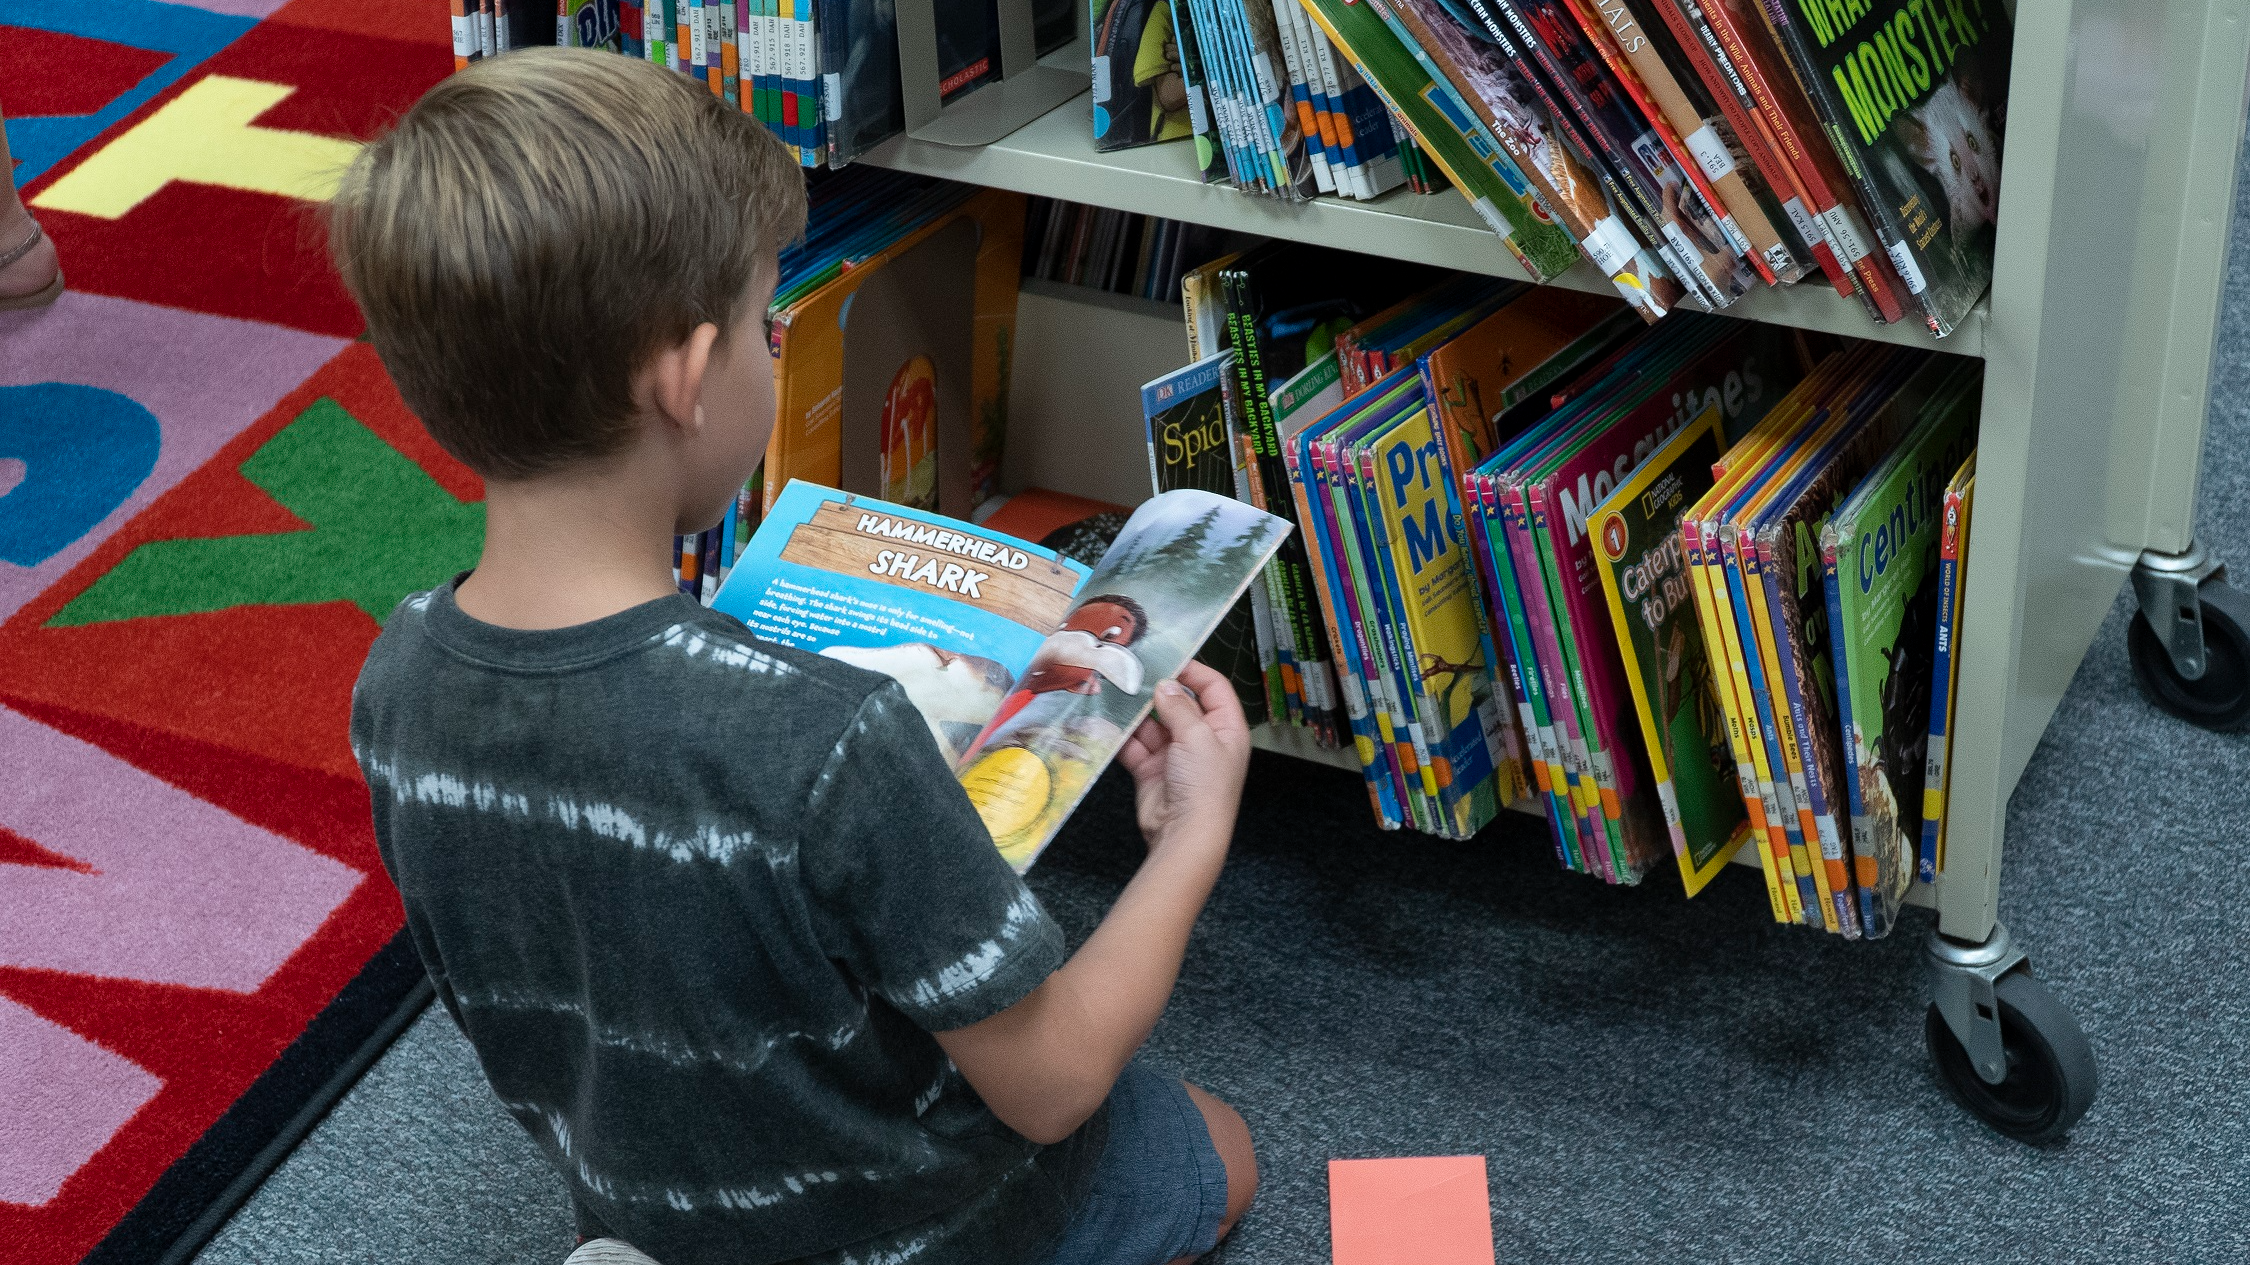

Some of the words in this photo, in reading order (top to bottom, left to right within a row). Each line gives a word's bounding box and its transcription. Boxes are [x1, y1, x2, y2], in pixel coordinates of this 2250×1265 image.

[1468, 0, 1488, 19] CEAN
[1483, 17, 1517, 57] MONSTERS
[1503, 8, 1538, 48] MONSTERS
[1798, 0, 1871, 48] WHA
[1282, 36, 1291, 50] KLI
[1317, 47, 1327, 61] KLI
[1582, 24, 1601, 48] Animal
[1597, 47, 1616, 71] Clowns
[1699, 24, 1719, 48] DEADLY
[1712, 46, 1749, 96] PREDATORS
[1698, 58, 1712, 75] HOW
[1708, 73, 1721, 90] AND
[1727, 103, 1737, 114] DO
[1714, 19, 1724, 29] in
[1719, 28, 1732, 43] the
[1727, 41, 1744, 63] Wild:
[1739, 62, 1763, 94] Animals
[1758, 93, 1773, 110] and
[1767, 108, 1785, 131] Their
[1779, 129, 1803, 160] Friends
[1353, 62, 1365, 74] my
[1362, 72, 1380, 90] little
[1376, 88, 1392, 105] book
[1389, 102, 1399, 113] of
[1395, 111, 1419, 137] animals
[1489, 119, 1509, 139] The
[1502, 135, 1523, 156] Zoo
[1699, 149, 1719, 173] 591.3
[1711, 152, 1726, 169] BEA
[1625, 174, 1636, 187] Free
[1633, 185, 1656, 214] Augmented
[1608, 181, 1619, 193] Free
[1616, 191, 1640, 220] Augmented
[1636, 217, 1651, 234] Reality
[1647, 233, 1658, 245] App
[1788, 207, 1805, 225] KAL
[1827, 209, 1842, 227] AMU
[1722, 218, 1738, 235] McG
[1799, 223, 1816, 242] 591.5
[1817, 219, 1830, 236] DEL
[1908, 222, 1918, 234] the
[1669, 235, 1685, 253] CAR
[1736, 235, 1750, 250] 591
[1828, 237, 1848, 266] 591.53
[1838, 227, 1861, 258] 591.56
[1597, 250, 1614, 265] HOE
[1665, 257, 1681, 275] CAR
[1681, 251, 1695, 265] 591
[1677, 273, 1689, 286] 591
[1862, 269, 1880, 293] Press
[1182, 295, 1194, 323] Looking
[1225, 311, 1245, 365] BEASTIES
[1240, 313, 1261, 366] BEASTIES
[1156, 384, 1174, 402] DK
[1177, 366, 1219, 394] READER
[1237, 366, 1248, 378] IN
[1251, 368, 1263, 380] IN
[1239, 379, 1252, 397] MY
[1254, 382, 1266, 399] MY
[1164, 402, 1226, 469] Spid
[1244, 398, 1264, 455] BACKYARD
[1257, 400, 1278, 457] BACKYARD
[1652, 472, 1674, 498] NATIONAL
[1653, 476, 1684, 510] GEOGRAPHIC
[1451, 512, 1462, 526] Do
[856, 514, 1029, 570] HAMMERHEAD
[1455, 527, 1467, 544] You
[1610, 529, 1621, 550] 1
[1458, 545, 1473, 570] Know
[869, 550, 989, 598] SHARK
[779, 579, 830, 598] hammerhead
[830, 592, 859, 605] shark's
[860, 601, 878, 610] nose
[879, 604, 886, 612] is
[888, 608, 905, 618] only
[905, 610, 919, 620] for
[1416, 582, 1432, 596] by
[1943, 587, 1949, 596] OF
[753, 610, 772, 619] near
[772, 615, 791, 624] each
[791, 620, 807, 628] eye.
[809, 623, 841, 636] Because
[765, 587, 806, 605] breathing.
[809, 599, 824, 608] The
[824, 603, 847, 614] shark
[848, 609, 876, 621] swings
[876, 615, 888, 624] its
[890, 618, 910, 630] head
[909, 626, 927, 636] side
[928, 630, 938, 639] to
[779, 604, 809, 618] forcing
[809, 611, 833, 622] water
[834, 617, 851, 627] into
[858, 623, 888, 636] nostril
[1642, 595, 1662, 631] to
[759, 625, 791, 636] nostrils
[791, 631, 806, 640] are
[1329, 625, 1342, 654] Crickets
[1351, 620, 1371, 660] Dragonflies
[1367, 619, 1387, 668] Grasshoppers
[1938, 625, 1948, 652] ANTS
[1382, 622, 1404, 670] Walkingsticks
[1397, 621, 1413, 650] Praying
[1405, 649, 1421, 681] Mantises
[1509, 663, 1522, 690] Beetles
[1526, 665, 1540, 696] Fireflies
[1573, 669, 1589, 709] Mosquitoes
[1558, 682, 1570, 699] Flies
[1792, 700, 1805, 721] Ants
[1728, 715, 1742, 738] Moths
[1745, 715, 1759, 740] Wasps
[1764, 723, 1776, 741] Ants
[1782, 714, 1794, 741] Bumble
[1788, 742, 1799, 760] Bees
[1797, 722, 1808, 739] and
[1801, 740, 1813, 762] Their
[1841, 724, 1858, 764] Centipedes
[1806, 763, 1819, 787] Nests
[1770, 886, 1782, 914] Howard
[1790, 898, 1799, 913] Hall
